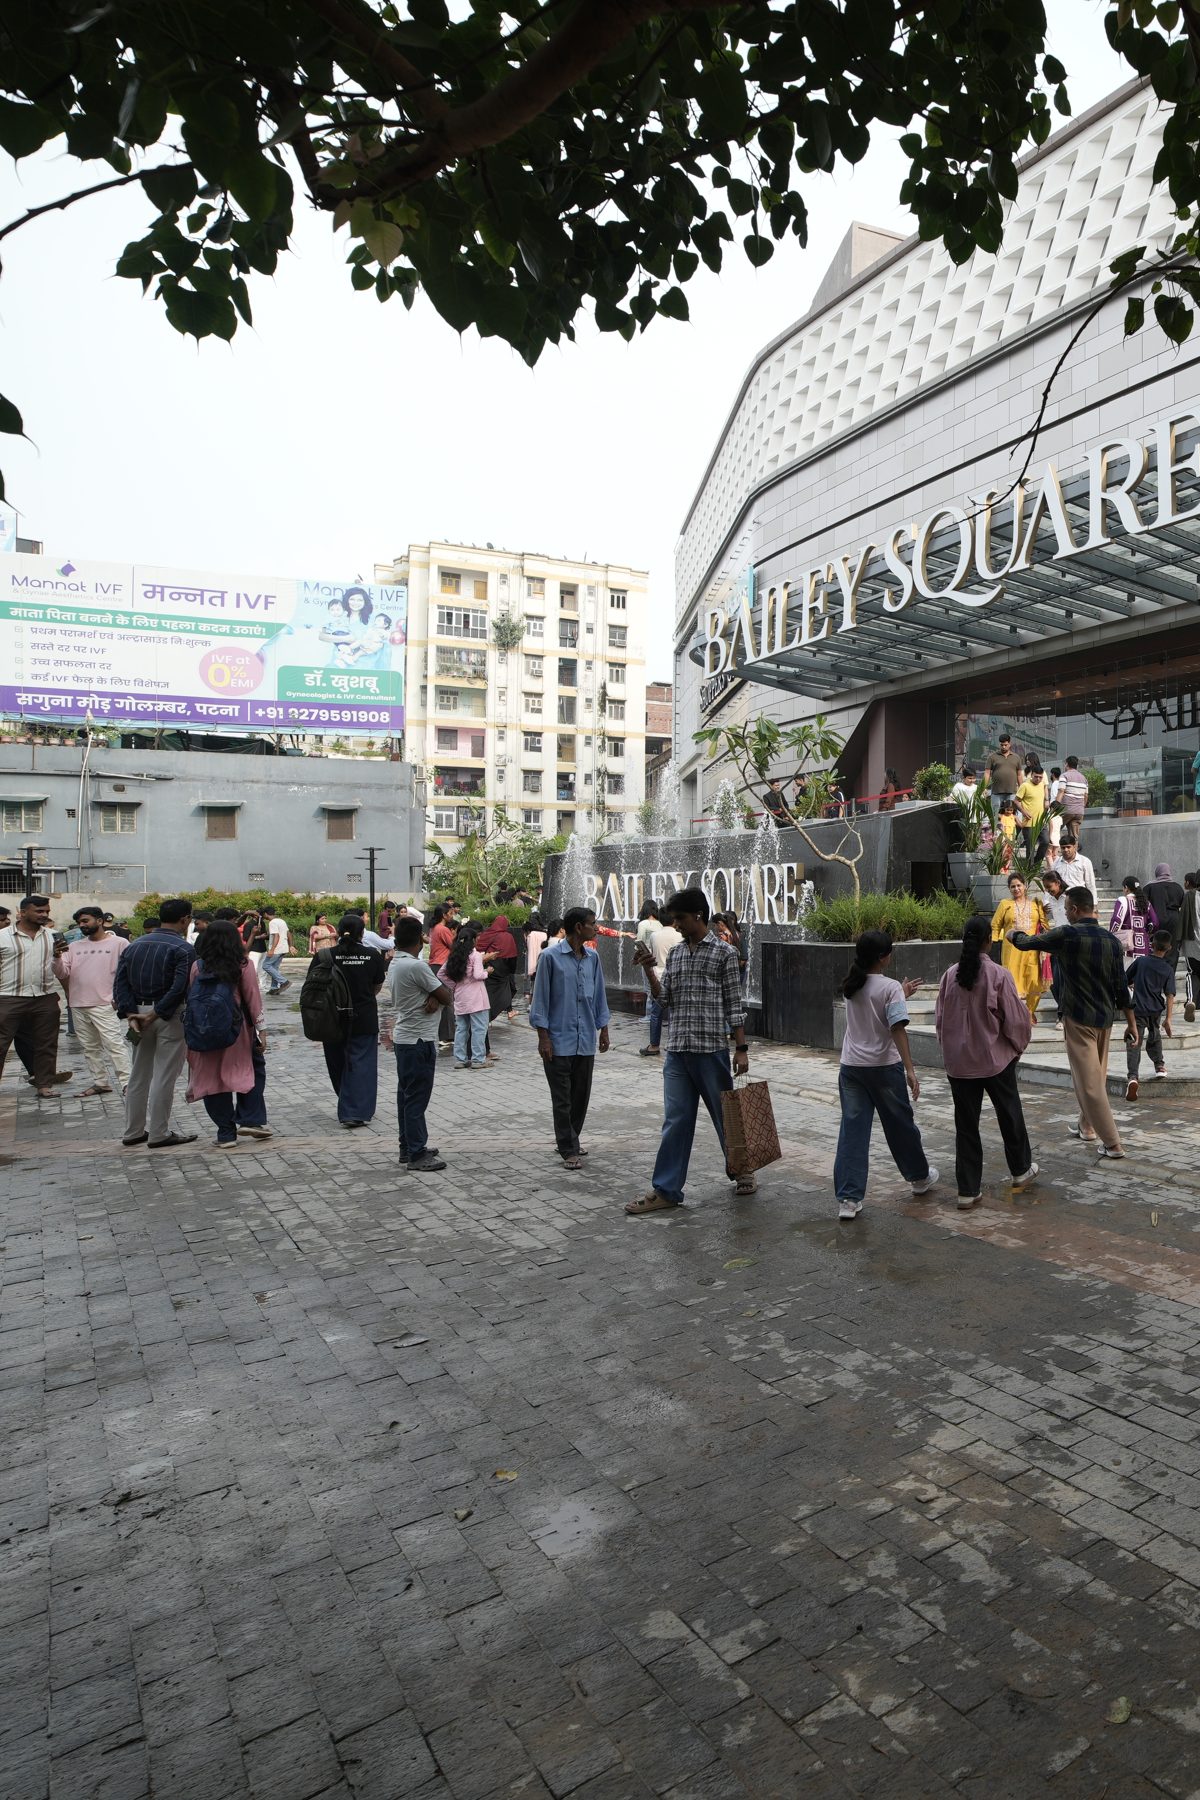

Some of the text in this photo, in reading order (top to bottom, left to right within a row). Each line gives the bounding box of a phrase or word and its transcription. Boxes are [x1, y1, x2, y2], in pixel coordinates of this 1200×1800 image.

[11, 575, 123, 595] Mannat IVF
[303, 581, 405, 603] Mant IVF
[96, 595, 123, 603] Centre
[142, 583, 228, 608] मन्नत
[236, 592, 277, 611] IVF
[380, 603, 404, 612] Centre
[702, 543, 877, 680] BAILEY
[9, 607, 43, 619] माता
[46, 608, 76, 621] पिता
[80, 612, 113, 624] बनने
[116, 613, 130, 626] के
[132, 615, 158, 627] लिए
[161, 619, 195, 631] पहला
[198, 622, 231, 634] कदम
[30, 626, 57, 636] प्रथम
[60, 629, 96, 639] परामर्श
[99, 631, 114, 640] एवं
[30, 641, 107, 655] सस्ते दर पर IVF
[30, 657, 112, 670] उच्च सफलता दर
[211, 655, 251, 665] IVF at
[30, 673, 170, 689] कई IVF फेल के लिए विशेषज्ञ
[231, 679, 254, 688] EMI
[304, 670, 380, 694] डॉ. खुशबू
[286, 690, 335, 700] Gynecologist
[16, 692, 240, 717] सगुना मोड़ गोलम्बर, पटना
[255, 706, 284, 720] +91
